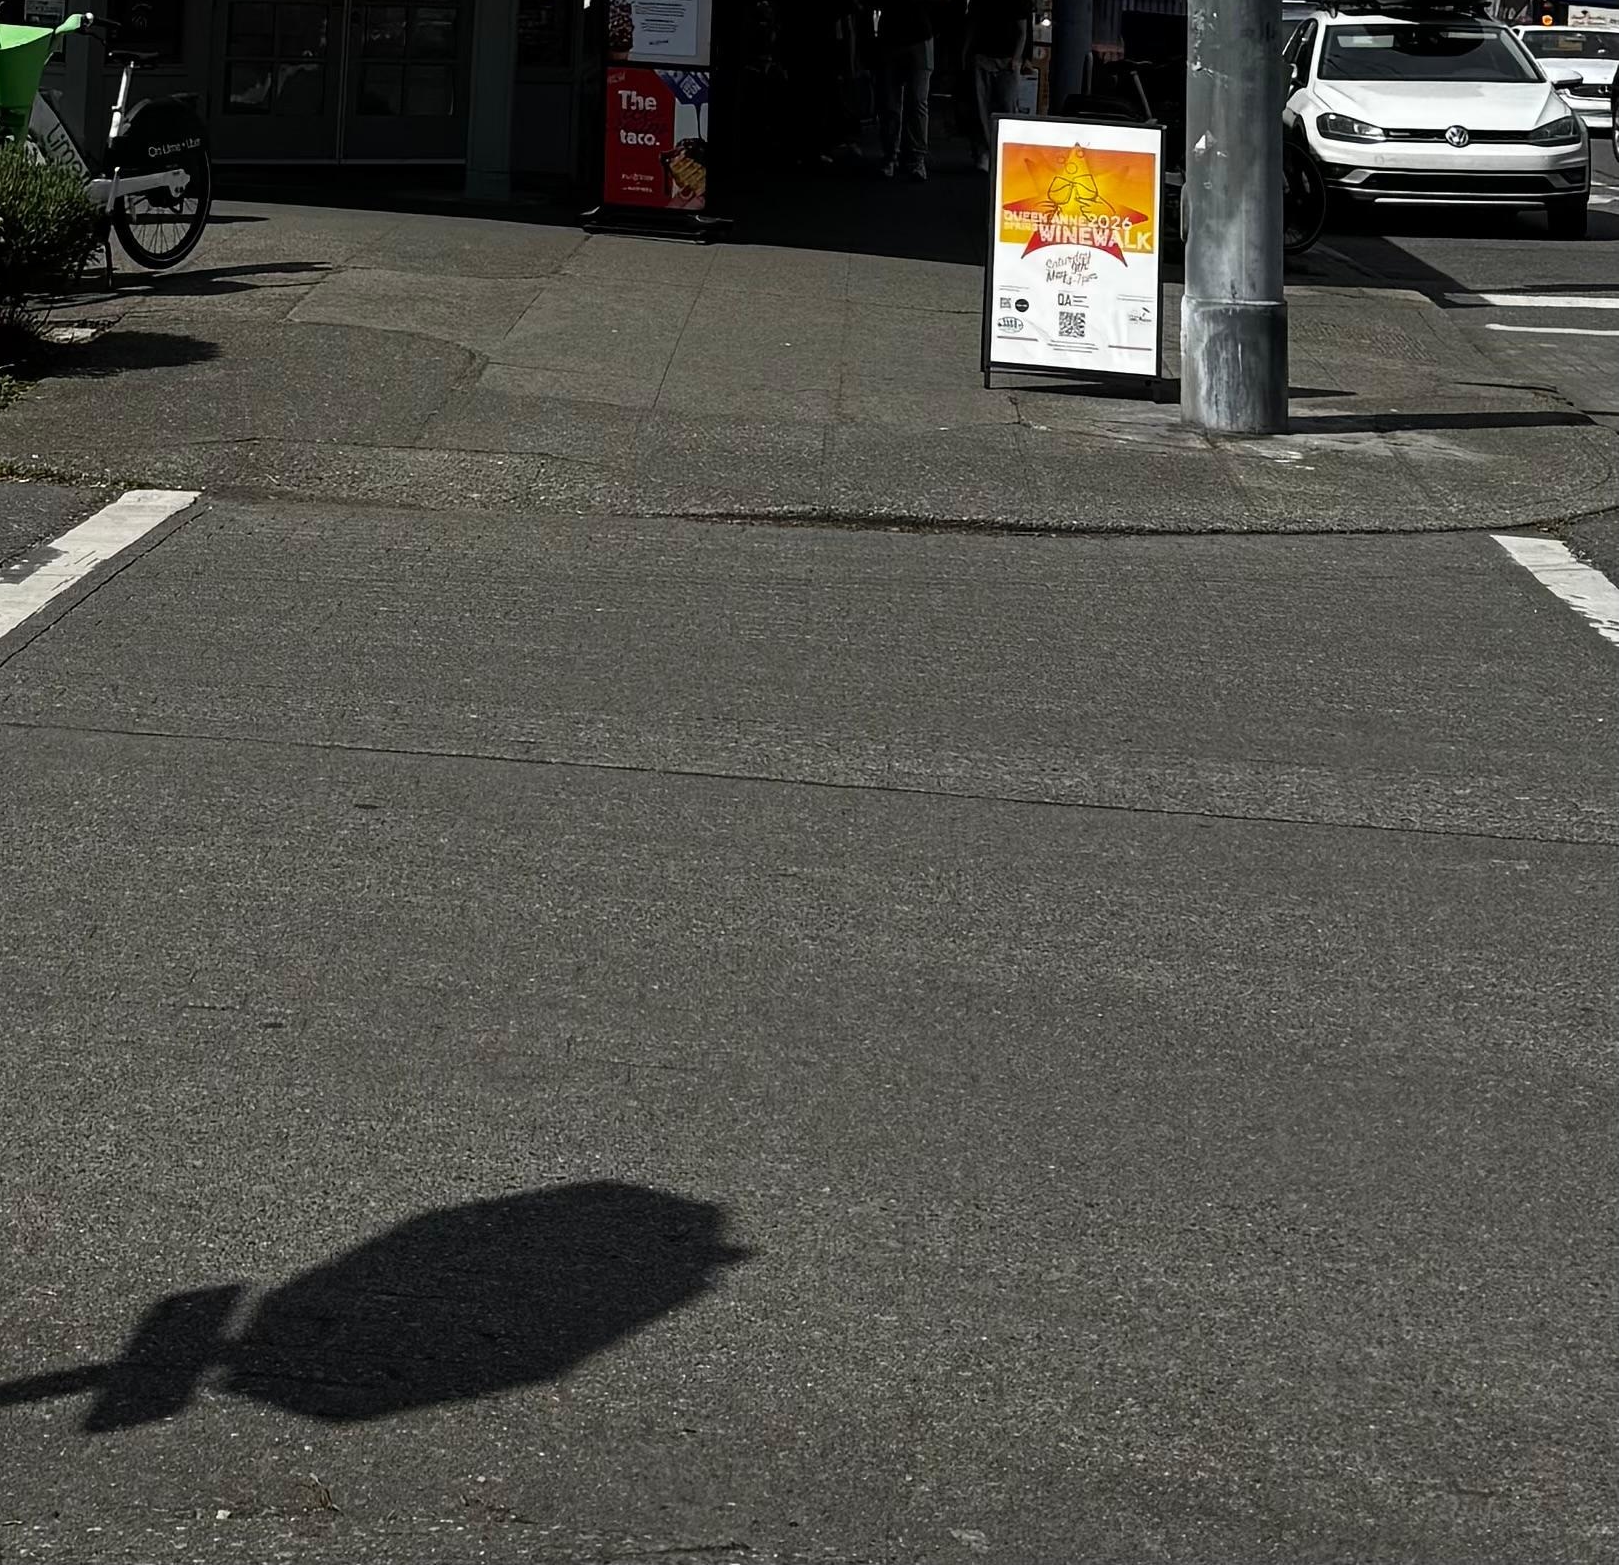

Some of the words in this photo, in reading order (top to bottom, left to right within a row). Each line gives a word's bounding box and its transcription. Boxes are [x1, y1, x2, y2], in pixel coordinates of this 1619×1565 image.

[617, 89, 658, 111] The
[619, 128, 661, 147] taco.
[1003, 210, 1048, 224] QUEEN
[1051, 211, 1089, 227] ANNE
[1087, 214, 1133, 231] 2026
